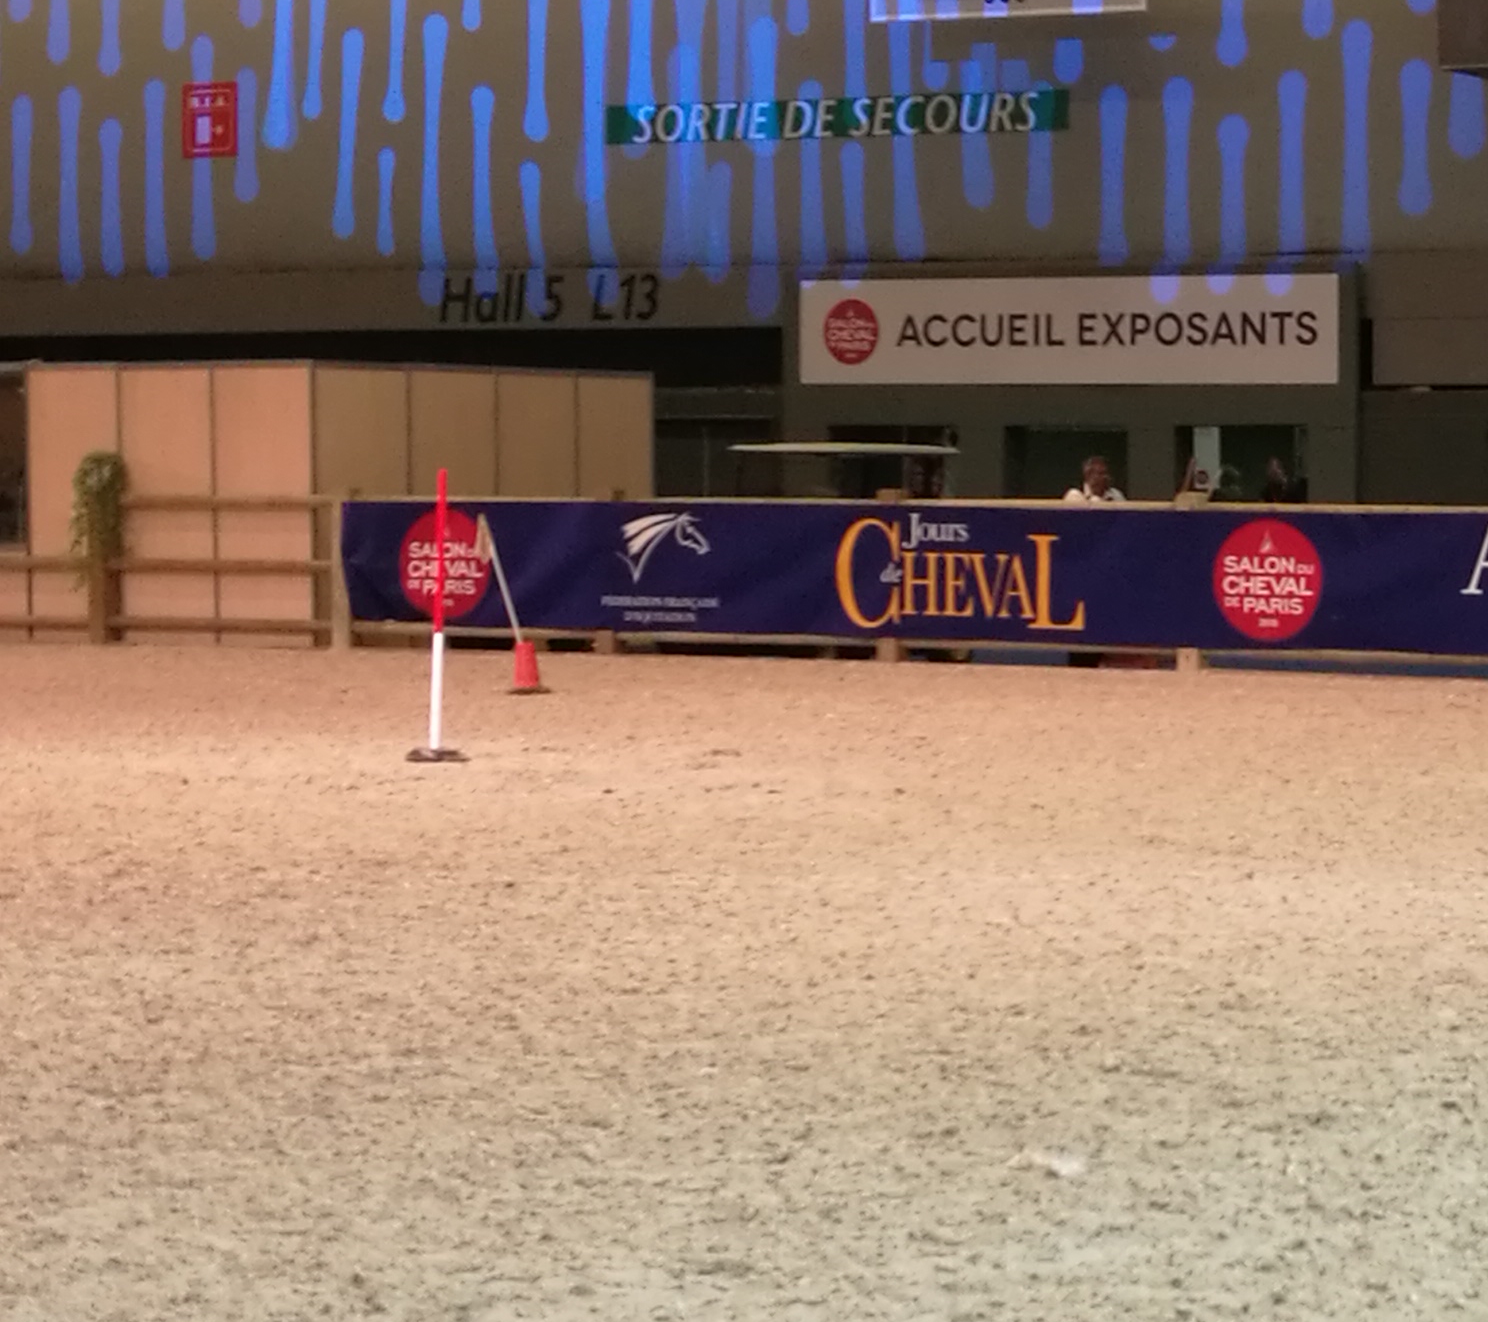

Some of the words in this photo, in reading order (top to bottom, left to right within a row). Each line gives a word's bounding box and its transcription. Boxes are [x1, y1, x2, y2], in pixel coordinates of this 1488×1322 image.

[632, 101, 769, 144] SORTIE
[783, 99, 835, 140] DE
[848, 91, 1040, 138] SECOURS
[440, 273, 525, 323] Hall
[540, 276, 564, 321] 5
[592, 273, 658, 321] L13
[897, 314, 1065, 348] ACCUEIL
[1078, 311, 1319, 347] EXPOSANTS
[902, 513, 970, 549] Jours
[407, 559, 484, 578] CHVAL
[835, 517, 1086, 631] CHEVAL
[1223, 555, 1295, 574] SALON
[1222, 575, 1314, 596] CHEVAL
[1242, 597, 1303, 615] PARIS
